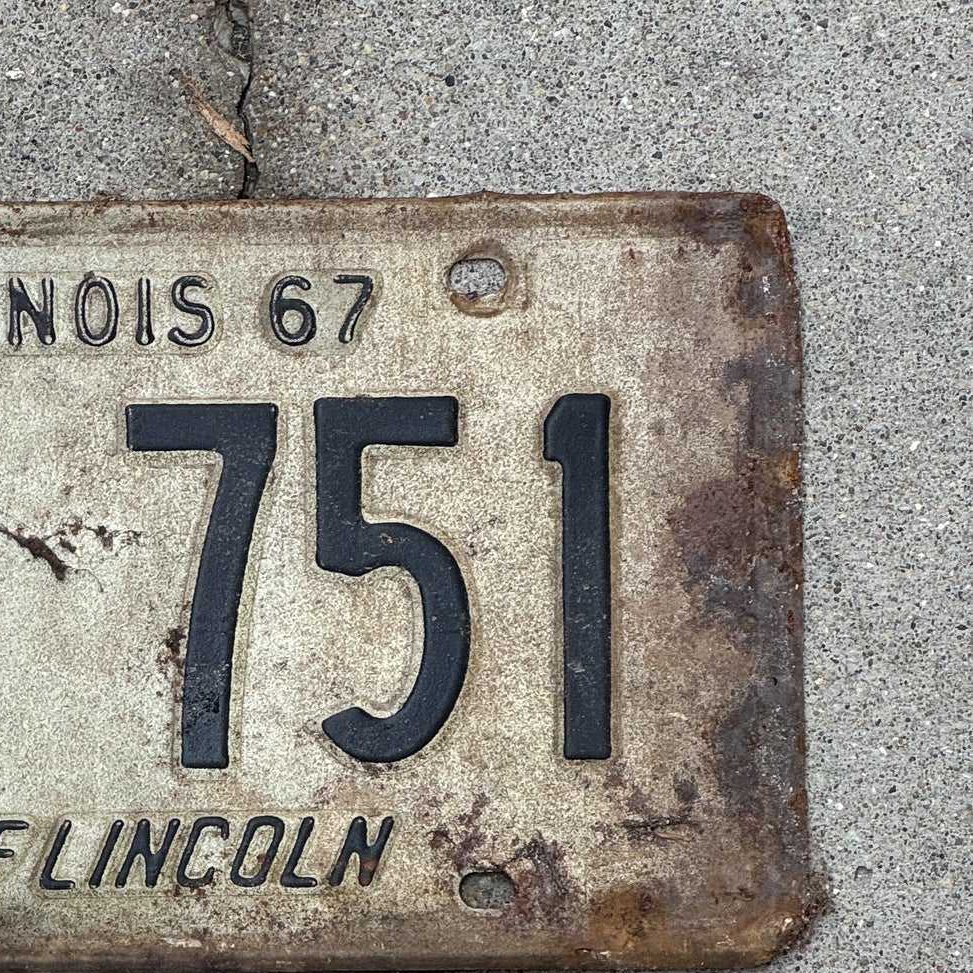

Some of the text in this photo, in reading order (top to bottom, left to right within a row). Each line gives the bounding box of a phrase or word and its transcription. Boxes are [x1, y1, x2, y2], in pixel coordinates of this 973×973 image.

[268, 274, 375, 347] 67
[124, 392, 615, 773] 751
[38, 814, 396, 891] LINCOLN
